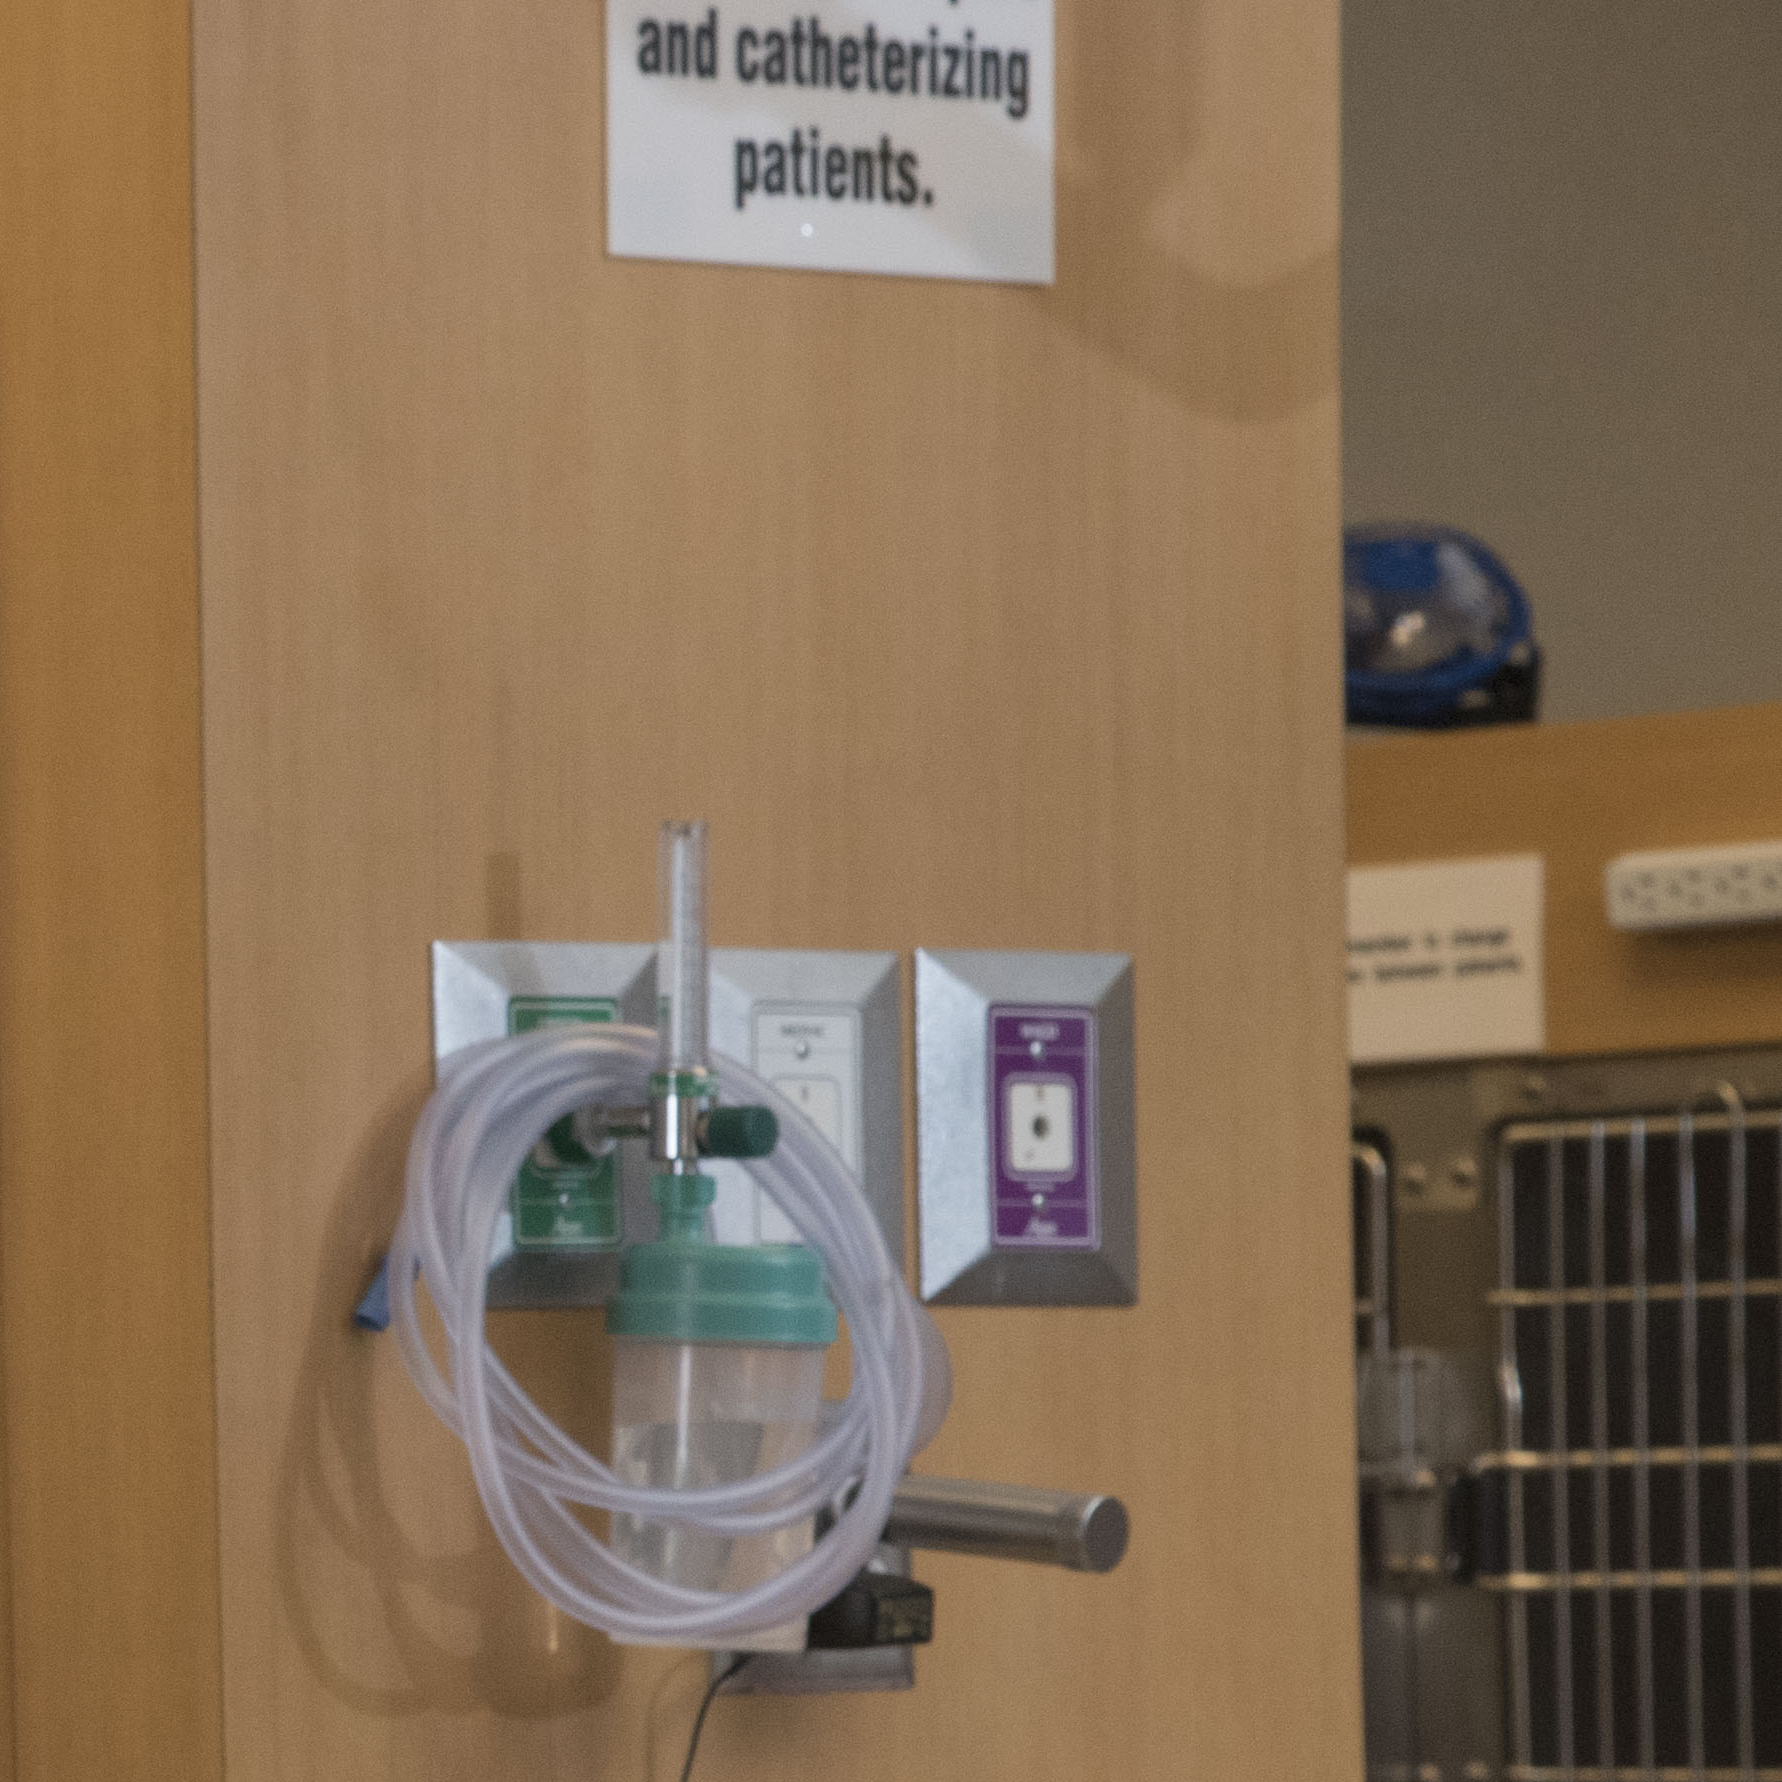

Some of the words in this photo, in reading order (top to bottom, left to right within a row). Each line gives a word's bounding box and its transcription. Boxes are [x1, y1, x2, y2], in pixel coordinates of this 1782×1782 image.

[637, 8, 719, 80] and
[736, 14, 1030, 120] catheterizing
[734, 126, 935, 210] patients.
